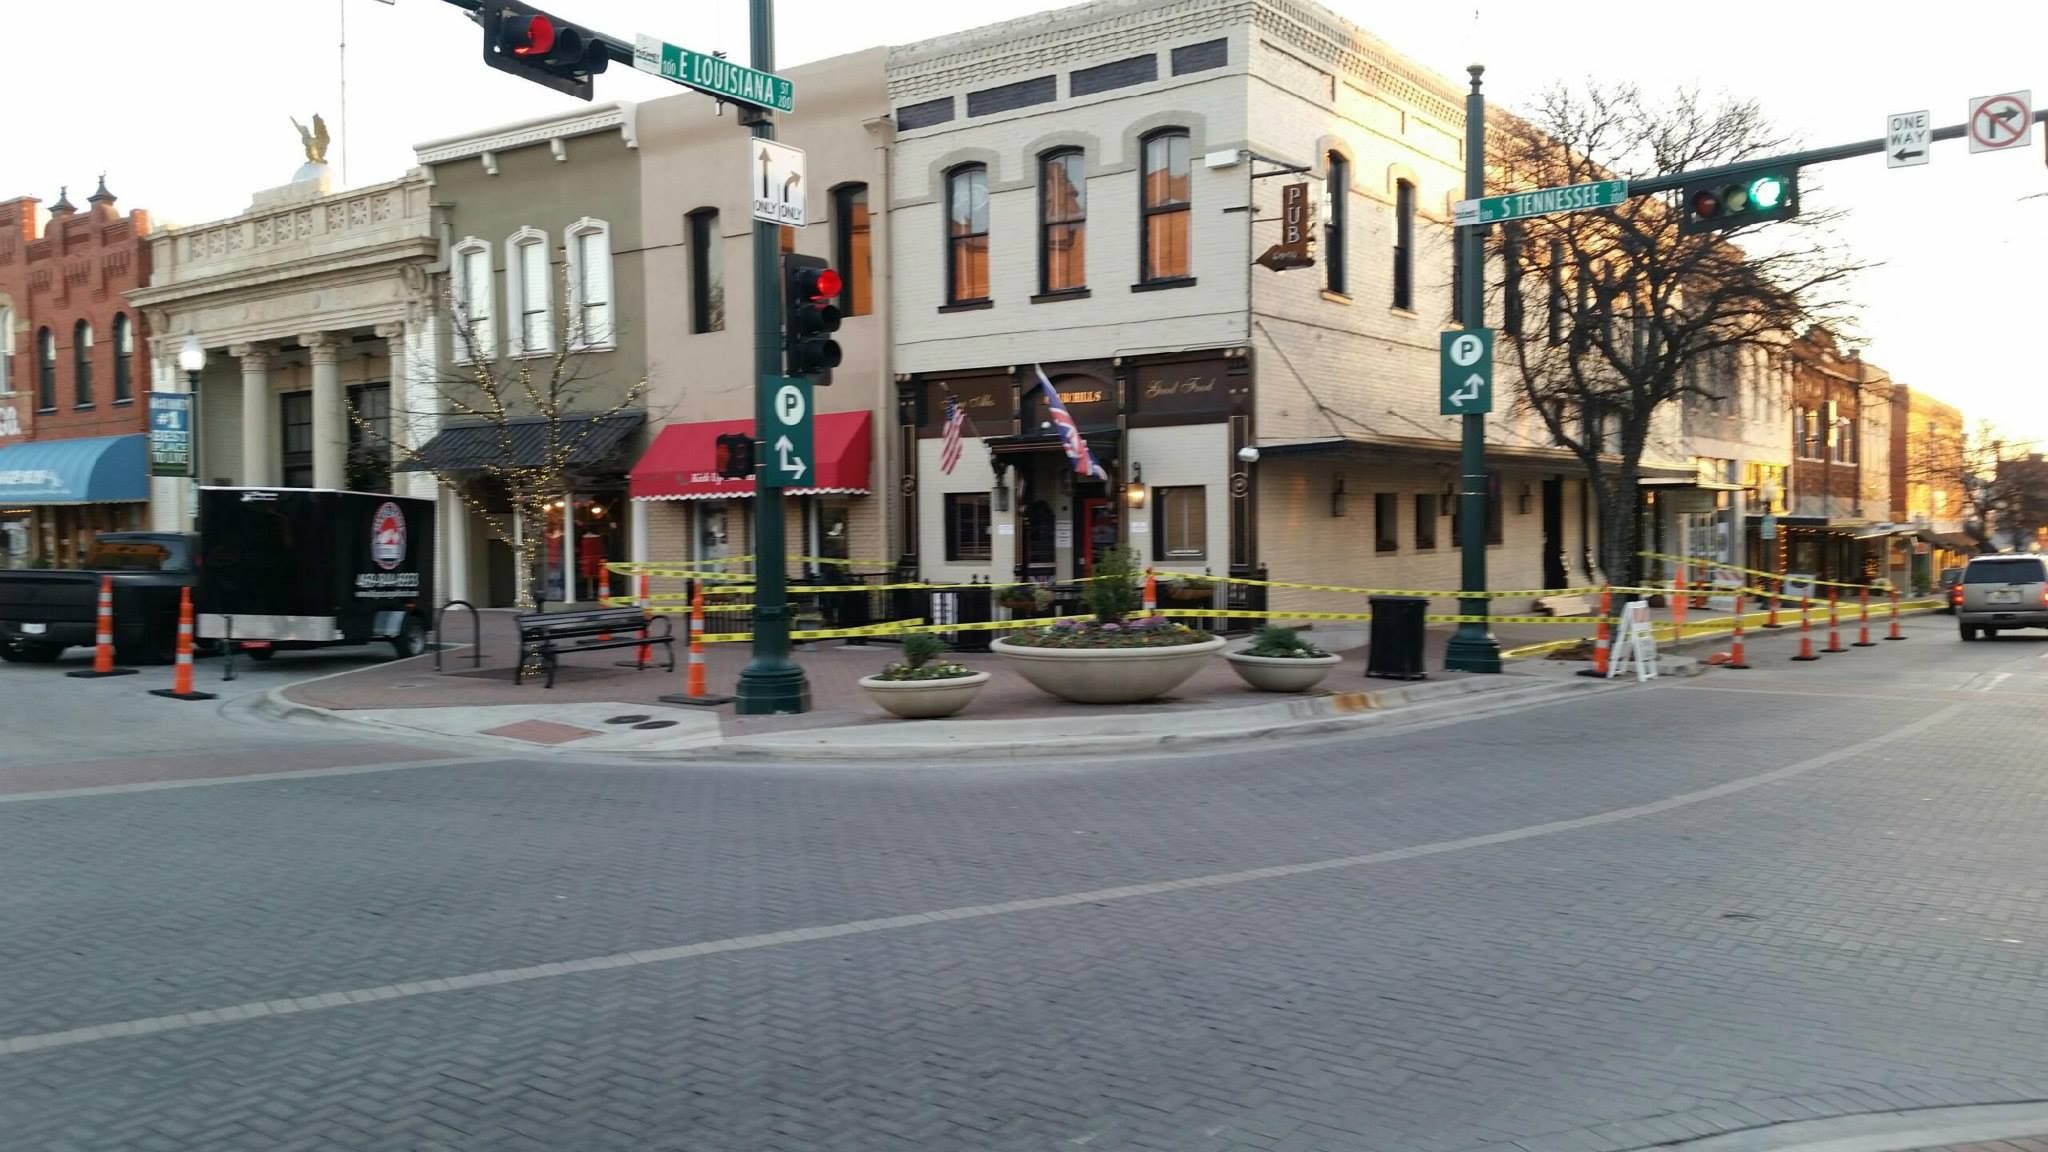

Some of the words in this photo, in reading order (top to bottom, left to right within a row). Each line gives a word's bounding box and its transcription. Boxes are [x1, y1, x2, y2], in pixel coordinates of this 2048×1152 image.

[663, 59, 676, 75] 100
[679, 51, 688, 78] E
[693, 55, 774, 104] LOUISIANA
[780, 82, 790, 94] ST
[778, 94, 793, 109] 200
[1892, 114, 1925, 131] ONE
[1890, 130, 1927, 146] WAY
[756, 200, 777, 215] ONLY
[1502, 197, 1511, 218] S
[1516, 184, 1601, 216] TENNESSEE
[780, 204, 802, 220] ONLY
[1287, 187, 1301, 244] PUB
[1461, 341, 1474, 361] P
[784, 393, 798, 417] P
[152, 431, 187, 442] BEST
